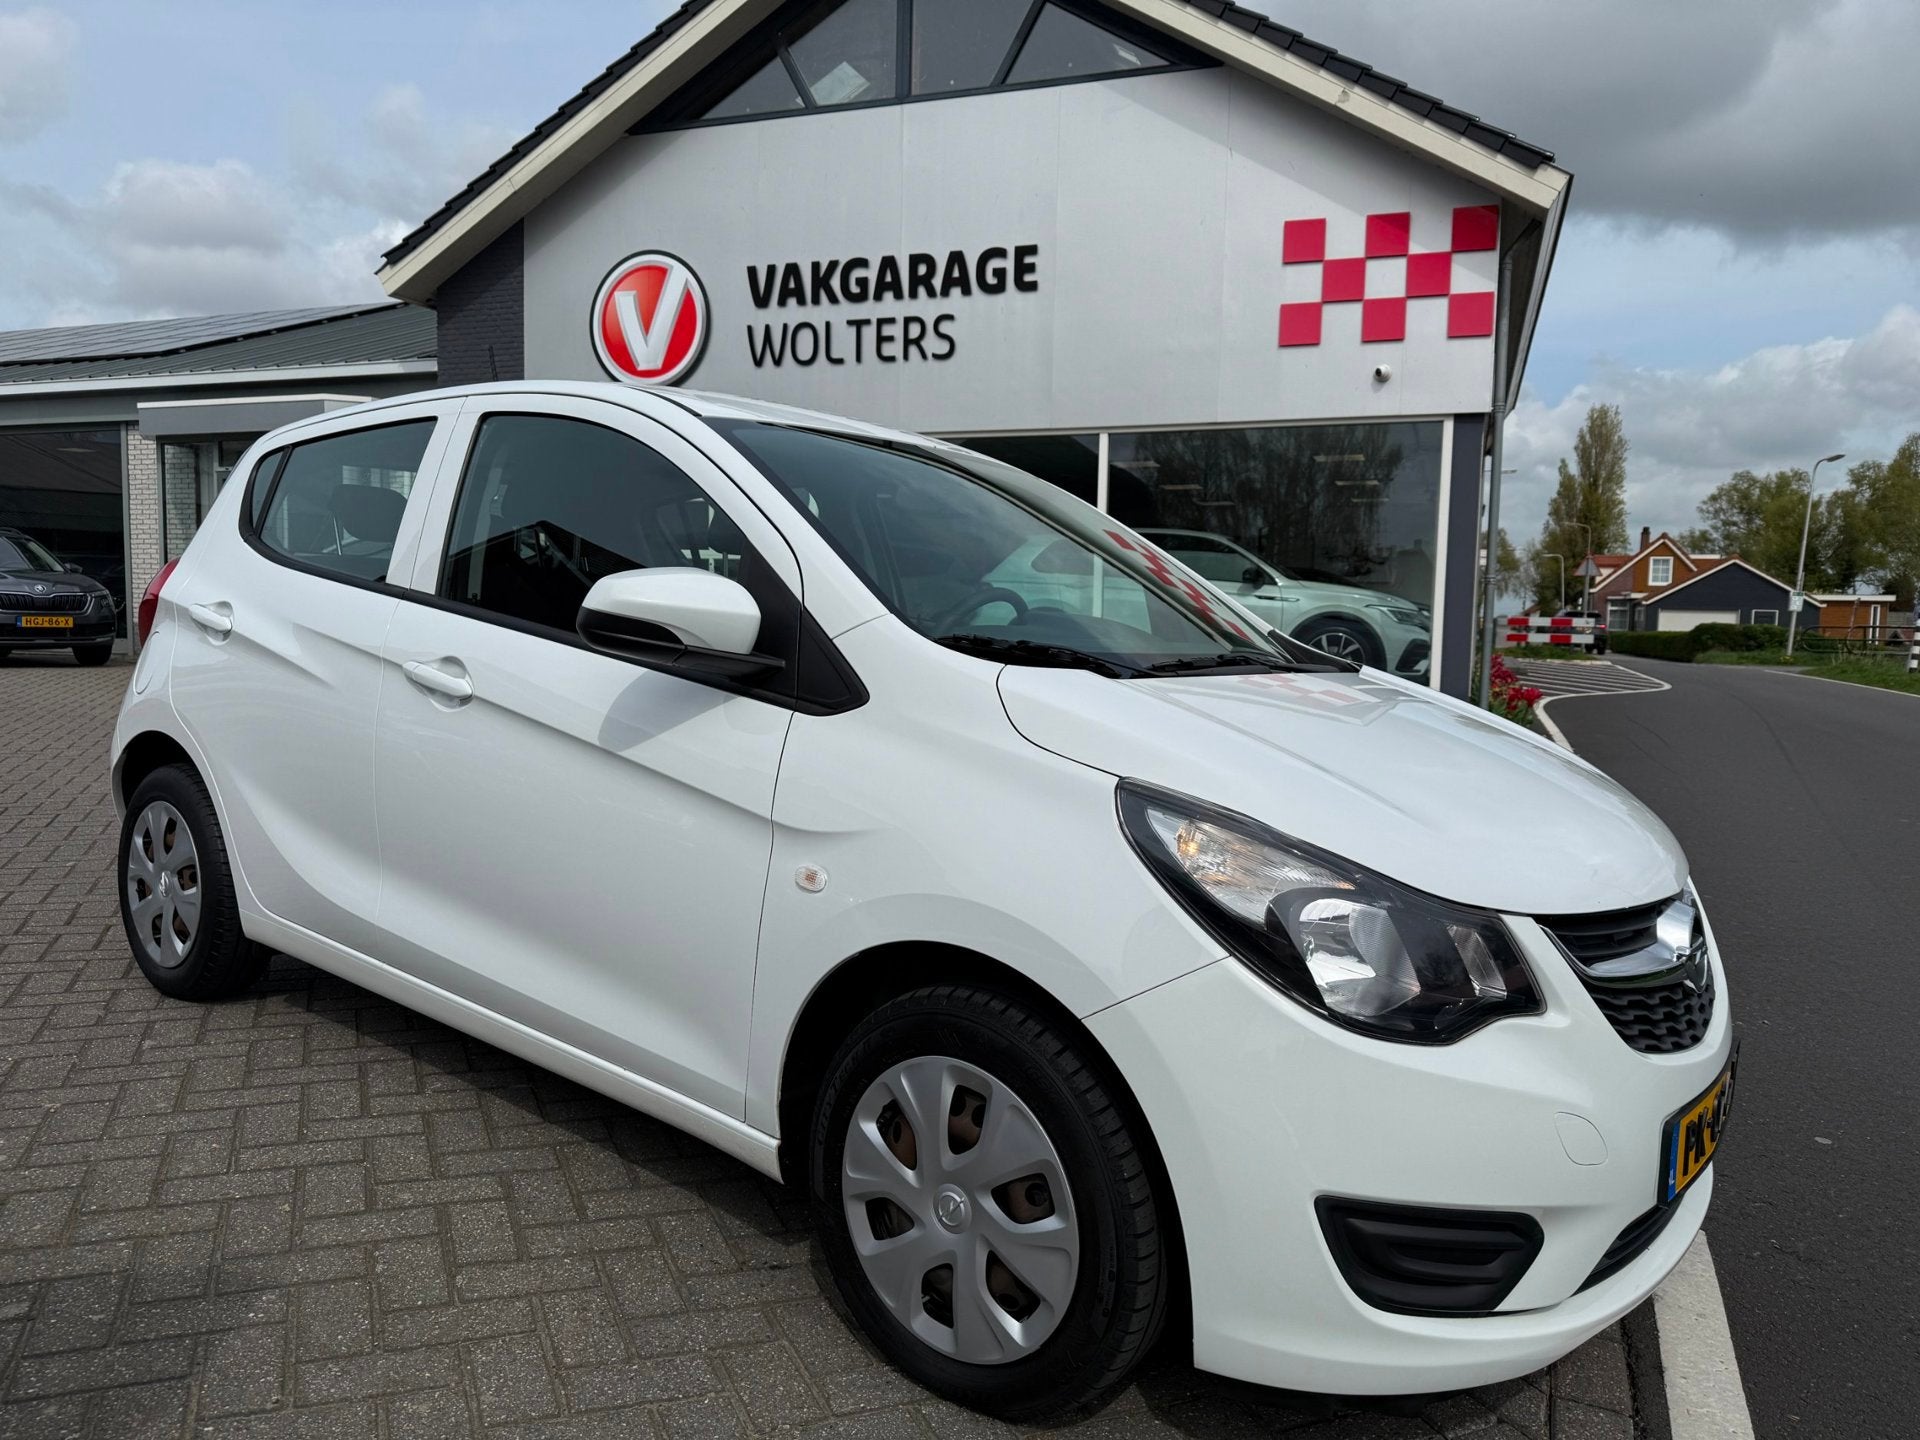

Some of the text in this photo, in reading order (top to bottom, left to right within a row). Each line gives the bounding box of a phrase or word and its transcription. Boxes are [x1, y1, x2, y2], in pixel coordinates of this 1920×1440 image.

[746, 244, 1038, 310] VAKGARAGE
[613, 260, 691, 371] V
[746, 313, 956, 369] WOLTERS
[25, 616, 70, 626] HGJ-86-X
